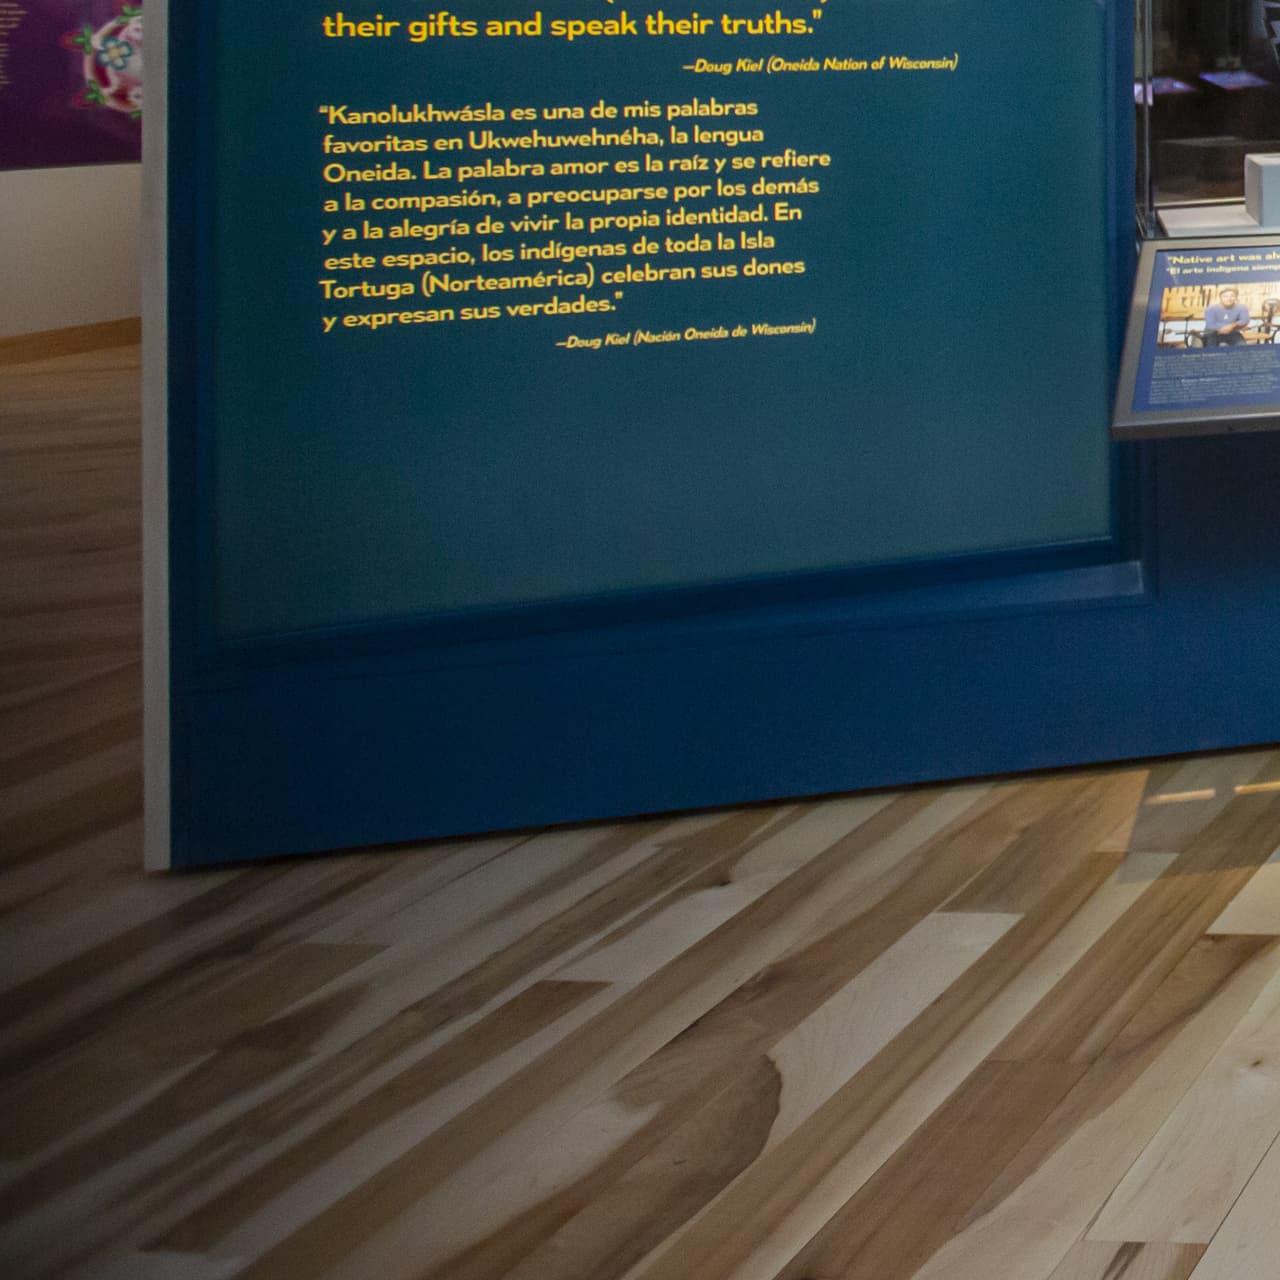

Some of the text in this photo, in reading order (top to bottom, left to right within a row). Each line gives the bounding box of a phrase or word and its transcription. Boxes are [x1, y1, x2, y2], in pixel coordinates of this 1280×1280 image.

[324, 12, 400, 37] their
[408, 11, 478, 43] gifts
[486, 11, 542, 36] and
[551, 11, 637, 41] speak
[646, 11, 713, 35] their
[736, 59, 764, 72] Kiel
[766, 56, 820, 74] (Oneida
[824, 58, 868, 70] Nation
[870, 56, 886, 70] of
[889, 52, 958, 70] Wisconsin)
[511, 108, 538, 120] es
[542, 107, 584, 120] una
[589, 100, 618, 119] de
[623, 100, 661, 118] mis
[666, 98, 758, 120] palabras
[323, 125, 764, 154] favoritas en Ukwehuwehnéha, la lengua
[323, 148, 831, 184] Oneida. La palabra amor es la raíz y se refiere
[323, 176, 819, 213] a la compasión, a preocuparse por los demás
[323, 202, 802, 245] y a la alegría de vivir la propia identidad. En
[324, 230, 775, 270] este espacio, los indígenas de toda la Isla
[1216, 254, 1235, 263] art
[1239, 254, 1262, 262] was
[320, 257, 805, 300] Tortuga (Norteamérica) celebran sus dones
[322, 317, 337, 333] y
[343, 309, 454, 330] expresan
[460, 306, 501, 320] sus
[604, 332, 631, 346] Kiel
[633, 331, 682, 345] (Nación
[683, 327, 729, 341] Oneida
[731, 326, 748, 338] de
[751, 317, 816, 335] Wisconsin)
